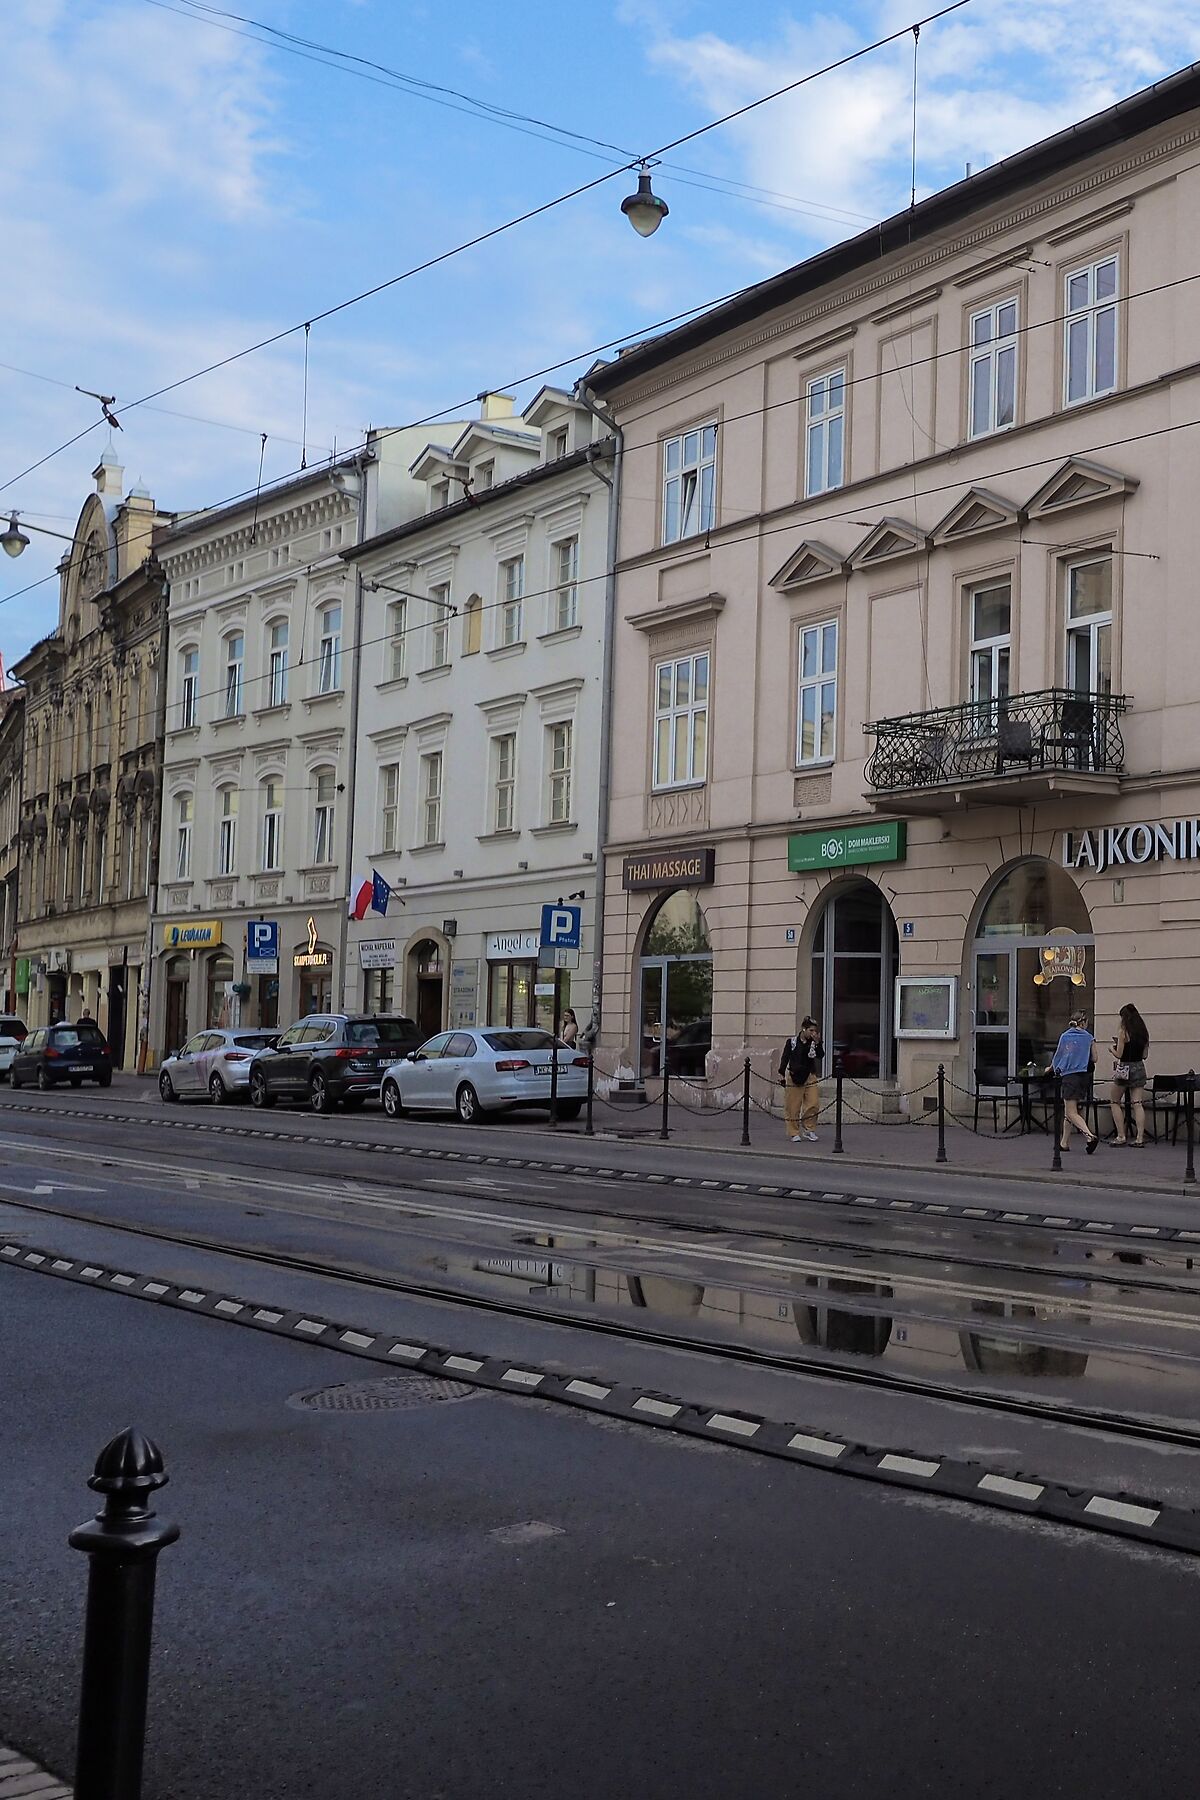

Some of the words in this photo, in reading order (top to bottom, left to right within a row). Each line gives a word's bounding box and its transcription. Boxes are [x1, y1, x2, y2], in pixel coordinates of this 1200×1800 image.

[627, 863, 650, 880] THAI
[652, 859, 701, 879] MASSAGE
[254, 924, 272, 947] P
[549, 910, 573, 942] P
[493, 933, 522, 954] Angel
